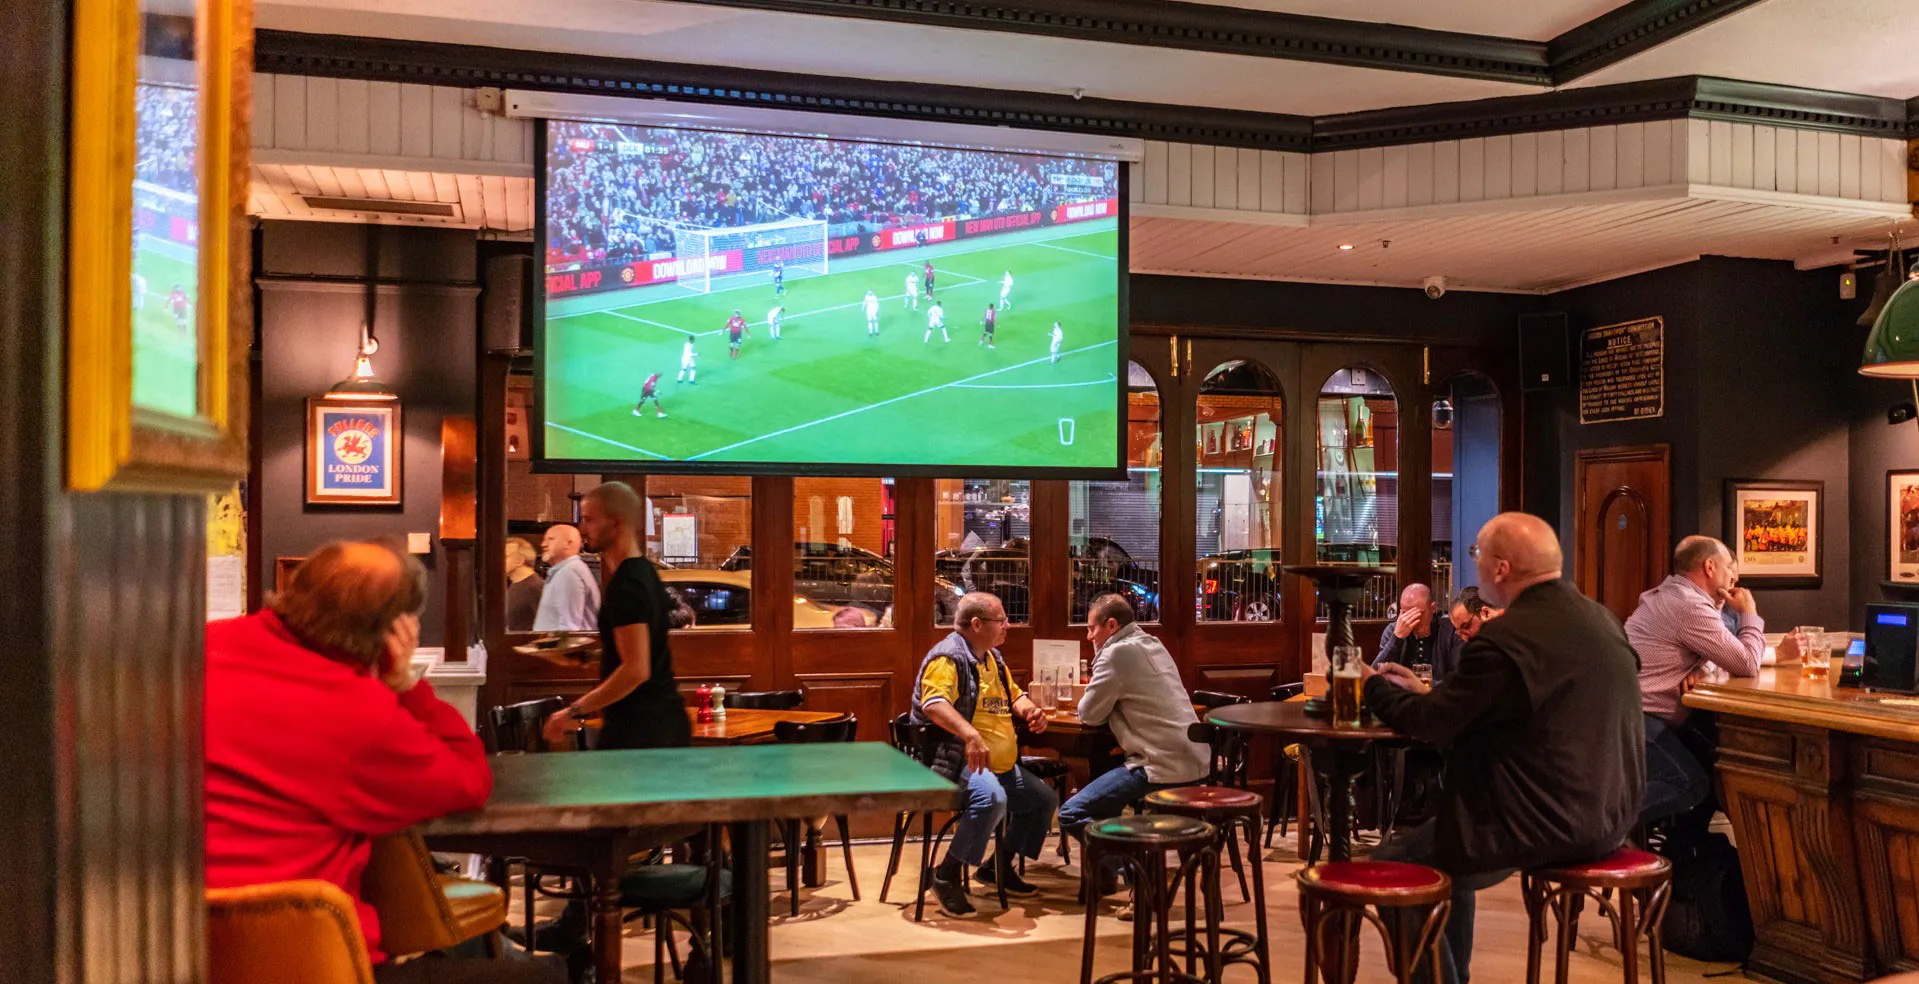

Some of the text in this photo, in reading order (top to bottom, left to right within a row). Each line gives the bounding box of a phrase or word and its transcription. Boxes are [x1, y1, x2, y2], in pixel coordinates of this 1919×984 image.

[930, 225, 944, 240] NOW
[846, 237, 860, 251] APP
[653, 257, 705, 279] DOWNLOAD
[580, 271, 602, 289] APP
[1608, 335, 1632, 347] NOTICE
[328, 464, 379, 474] LONDON
[335, 474, 373, 483] PRIDE
